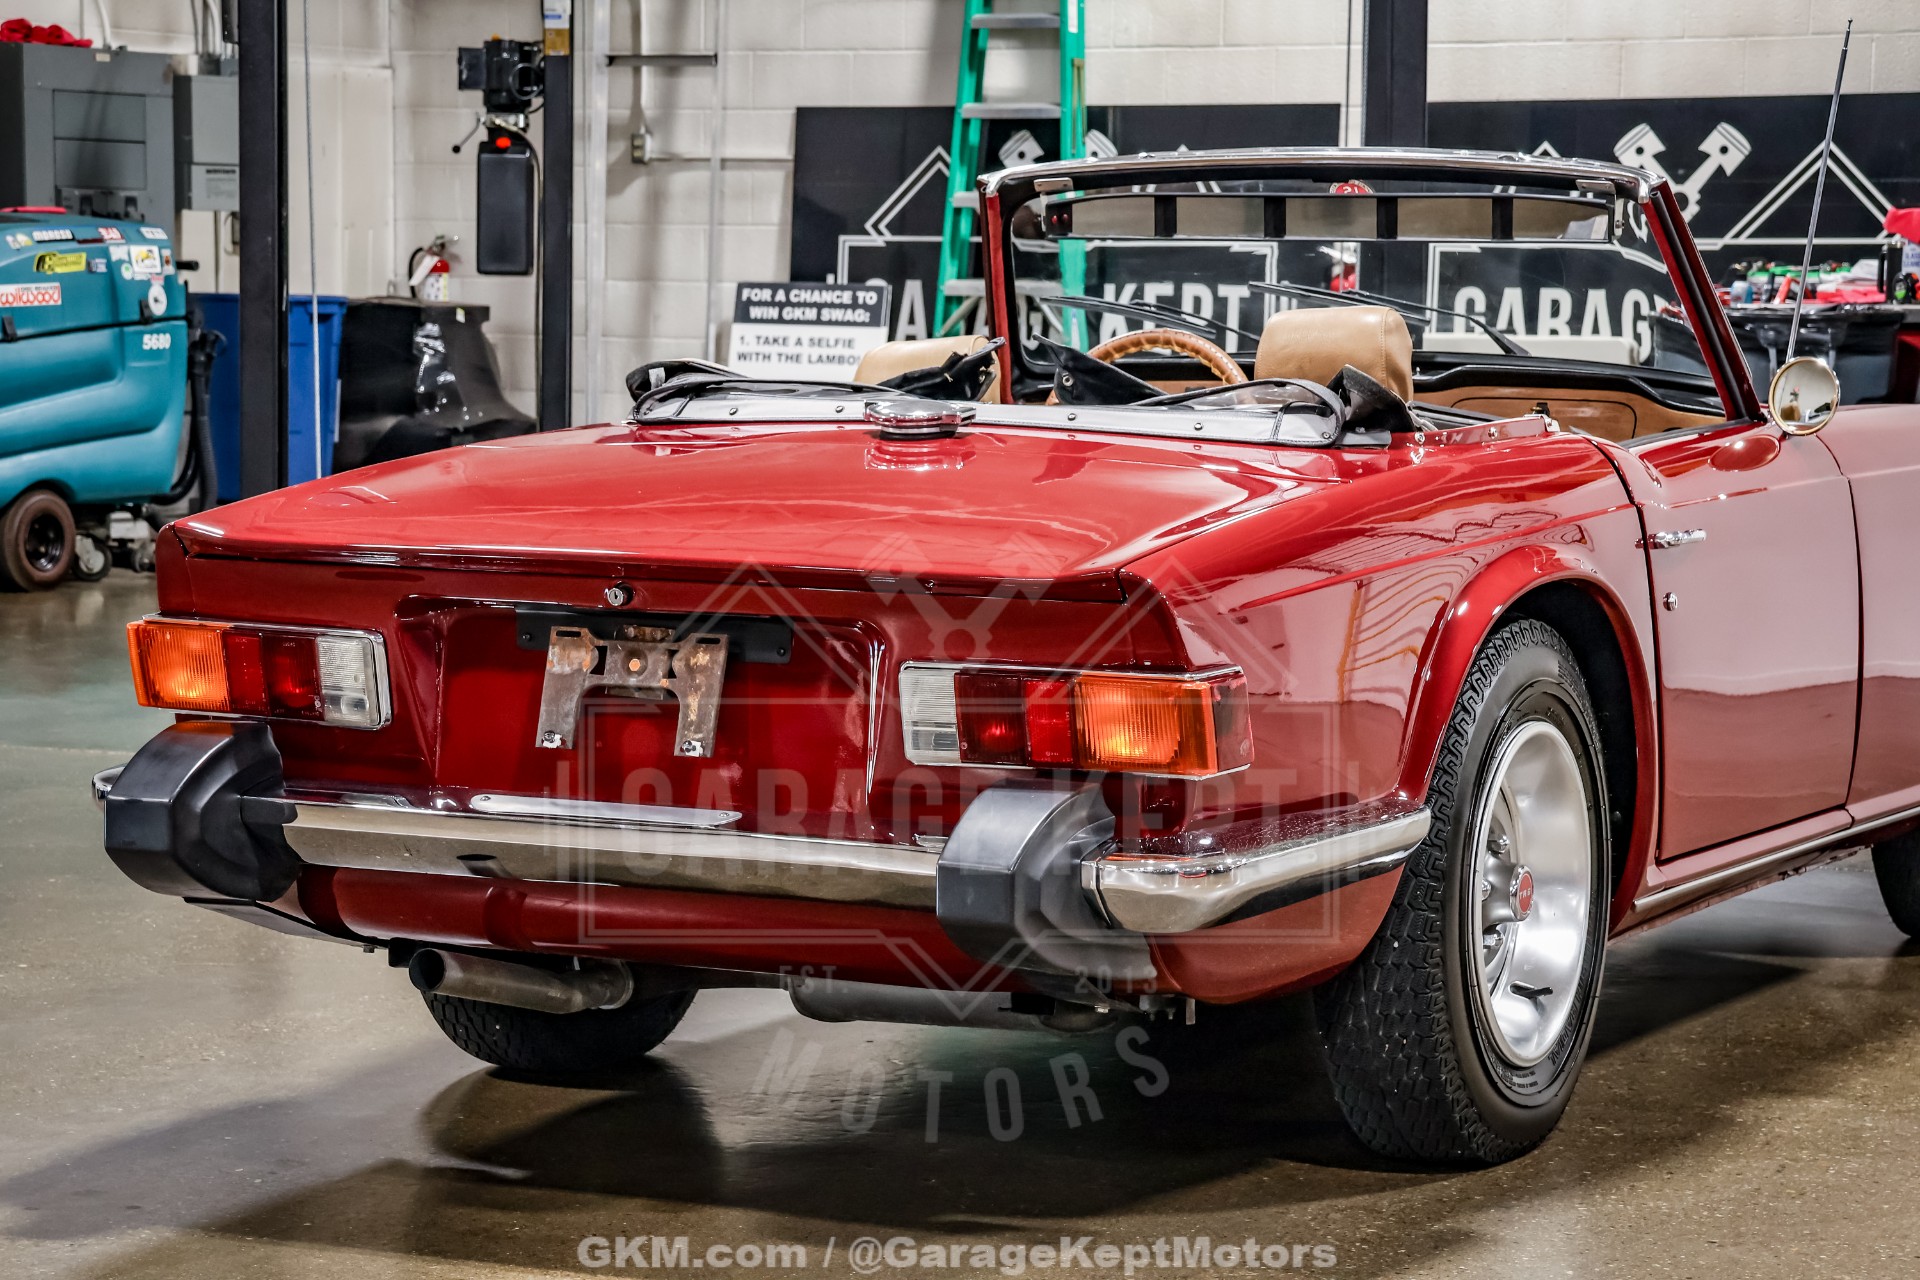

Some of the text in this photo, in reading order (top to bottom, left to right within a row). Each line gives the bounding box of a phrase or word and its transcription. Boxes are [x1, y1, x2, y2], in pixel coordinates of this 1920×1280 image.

[741, 288, 878, 305] FOR A CHANCE TO
[749, 306, 870, 323] WIN GKM SWAG:
[1453, 286, 1670, 364] GARAG
[739, 335, 856, 350] 1. TAKE A SELFIE
[737, 351, 771, 363] WITH
[777, 352, 801, 364] THE
